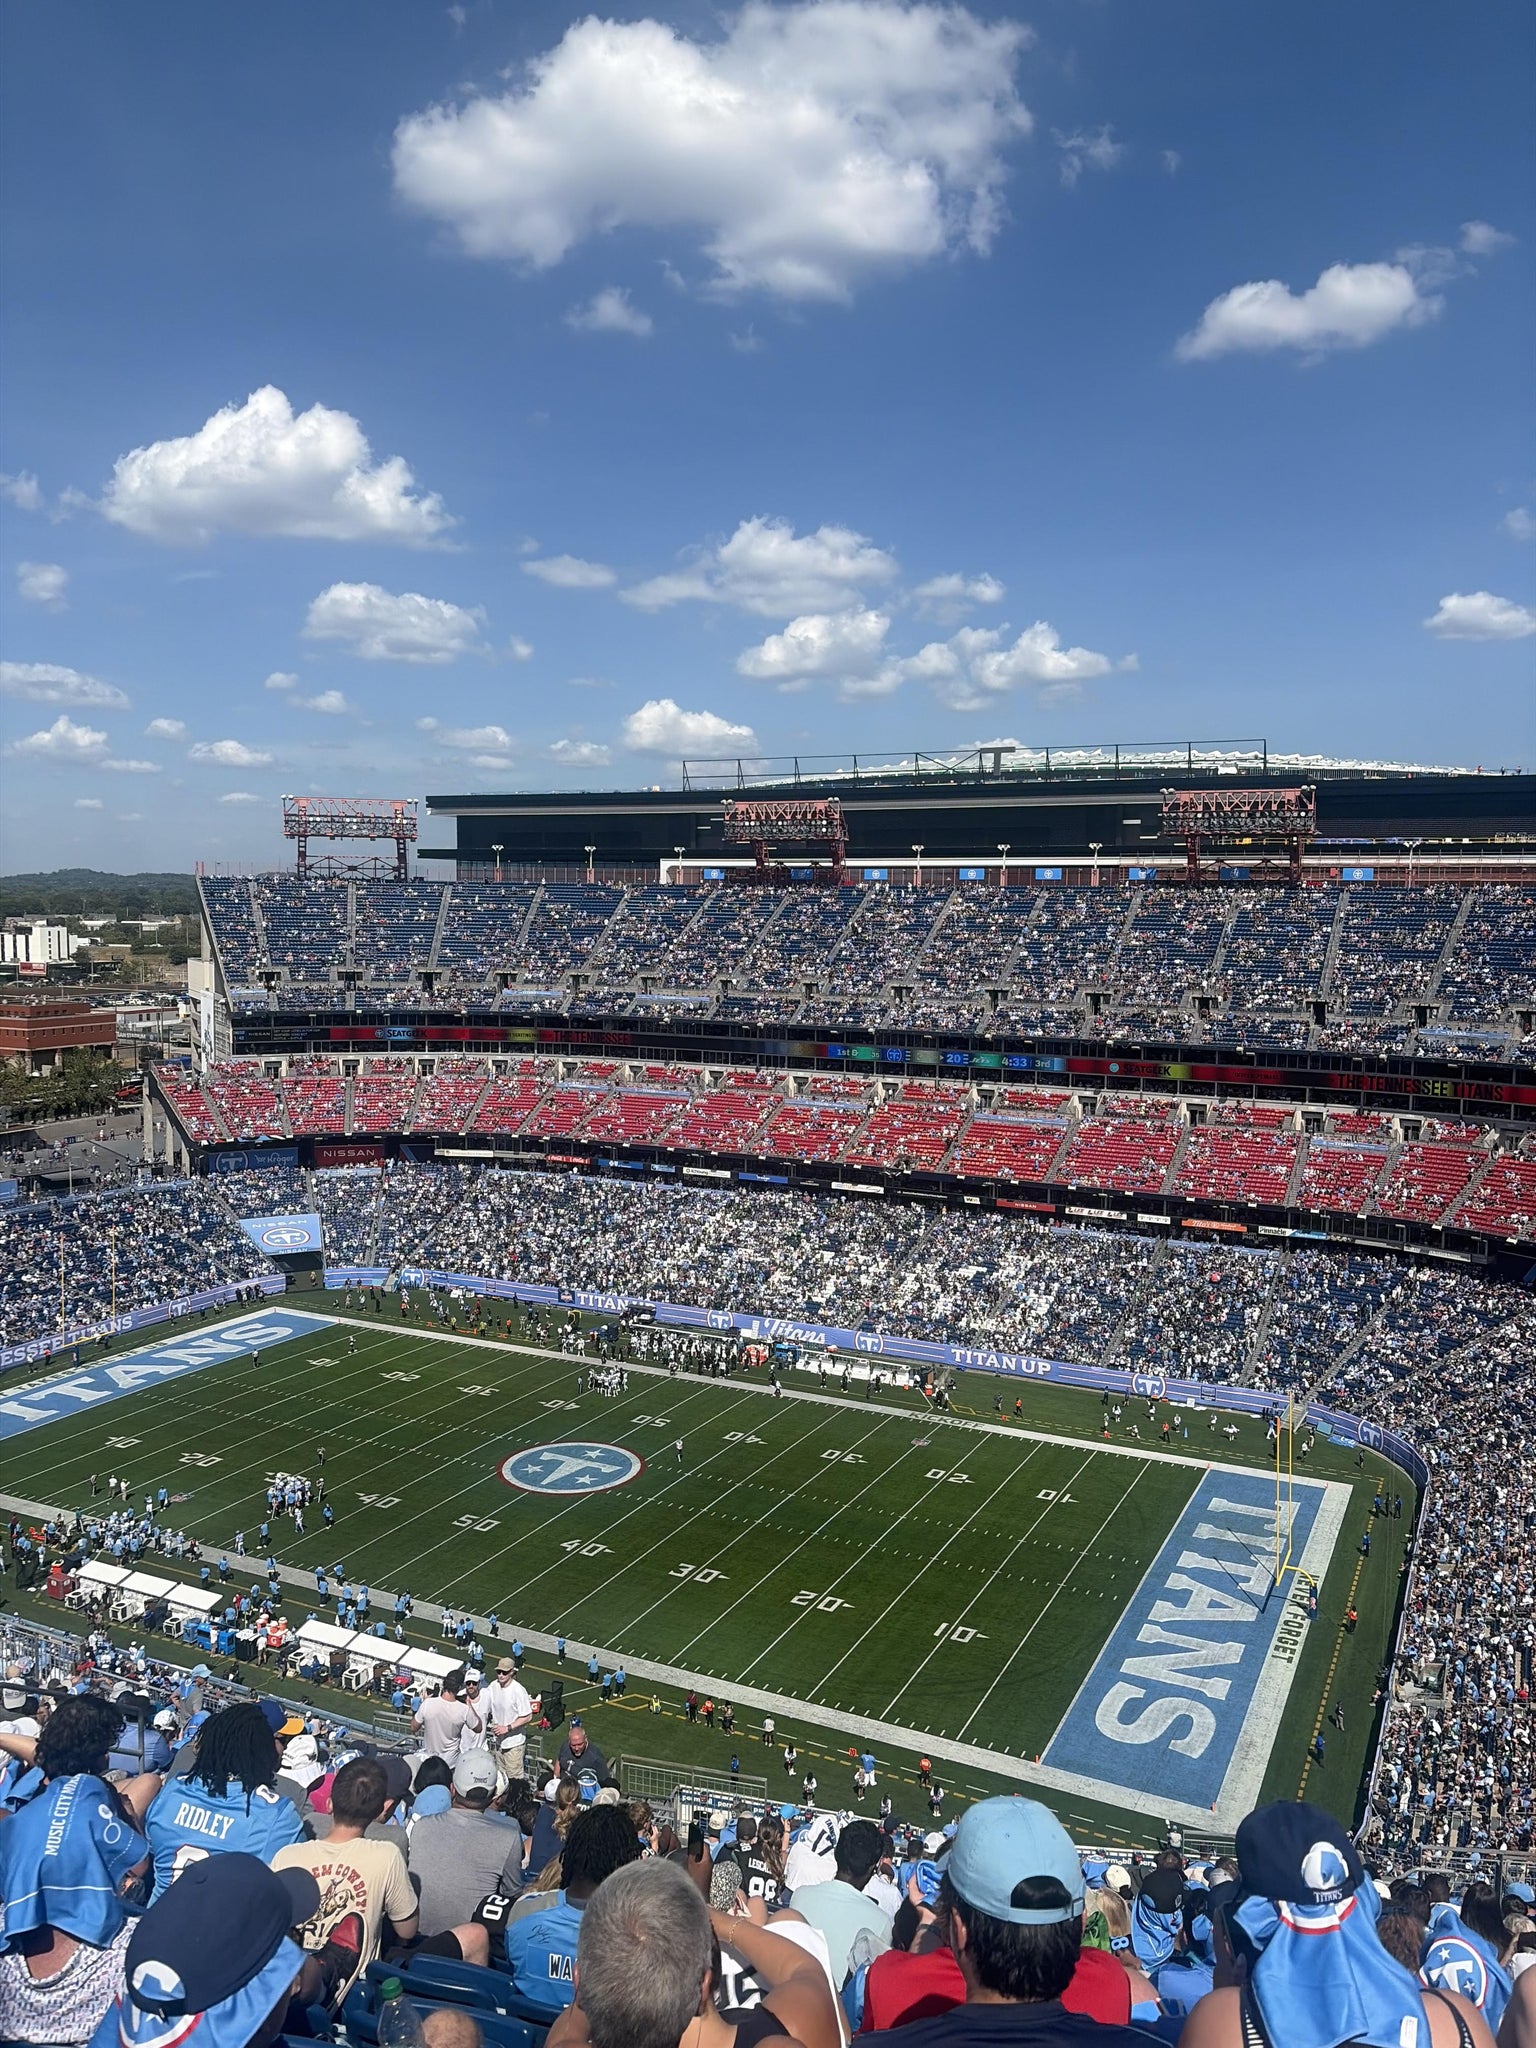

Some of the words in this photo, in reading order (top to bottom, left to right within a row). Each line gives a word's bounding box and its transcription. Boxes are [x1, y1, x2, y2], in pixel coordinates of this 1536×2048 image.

[946, 1054, 961, 1063] 20
[1001, 1057, 1027, 1067] 4:33
[1034, 1060, 1051, 1068] 3rd
[1338, 1073, 1364, 1090] THE
[1367, 1074, 1449, 1097] TENNESSEE
[1453, 1080, 1504, 1102] TITANS
[323, 1149, 375, 1158] NISSAN
[252, 1220, 307, 1228] NISSAN
[1259, 1226, 1287, 1236] Pinnacle
[68, 1316, 133, 1342] TITANS
[764, 1318, 816, 1344] Titans
[951, 1348, 1016, 1371] TITAN
[1021, 1357, 1052, 1376] UP
[384, 1371, 421, 1382] 20
[462, 1385, 500, 1396] 30
[543, 1399, 581, 1411] 40
[630, 1414, 671, 1428] 50
[909, 1411, 985, 1429] KICKOFF
[722, 1431, 761, 1445] 40
[178, 1453, 224, 1467] 20
[820, 1449, 863, 1464] 30
[924, 1468, 969, 1484] 20
[357, 1493, 402, 1509] 40
[1035, 1489, 1072, 1503] 10
[452, 1514, 501, 1532] 50
[559, 1539, 607, 1557] 40
[668, 1562, 720, 1584] 30
[790, 1590, 846, 1613] 20
[933, 1622, 979, 1644] 10
[1095, 1497, 1300, 1759] TITANS
[1271, 1611, 1306, 1664] FORGET
[54, 1795, 73, 1817] CITY
[173, 1802, 235, 1840] RIDLEY
[45, 1819, 66, 1857] MUSIC
[1313, 1888, 1343, 1904] TITANS
[482, 1894, 510, 1921] 20
